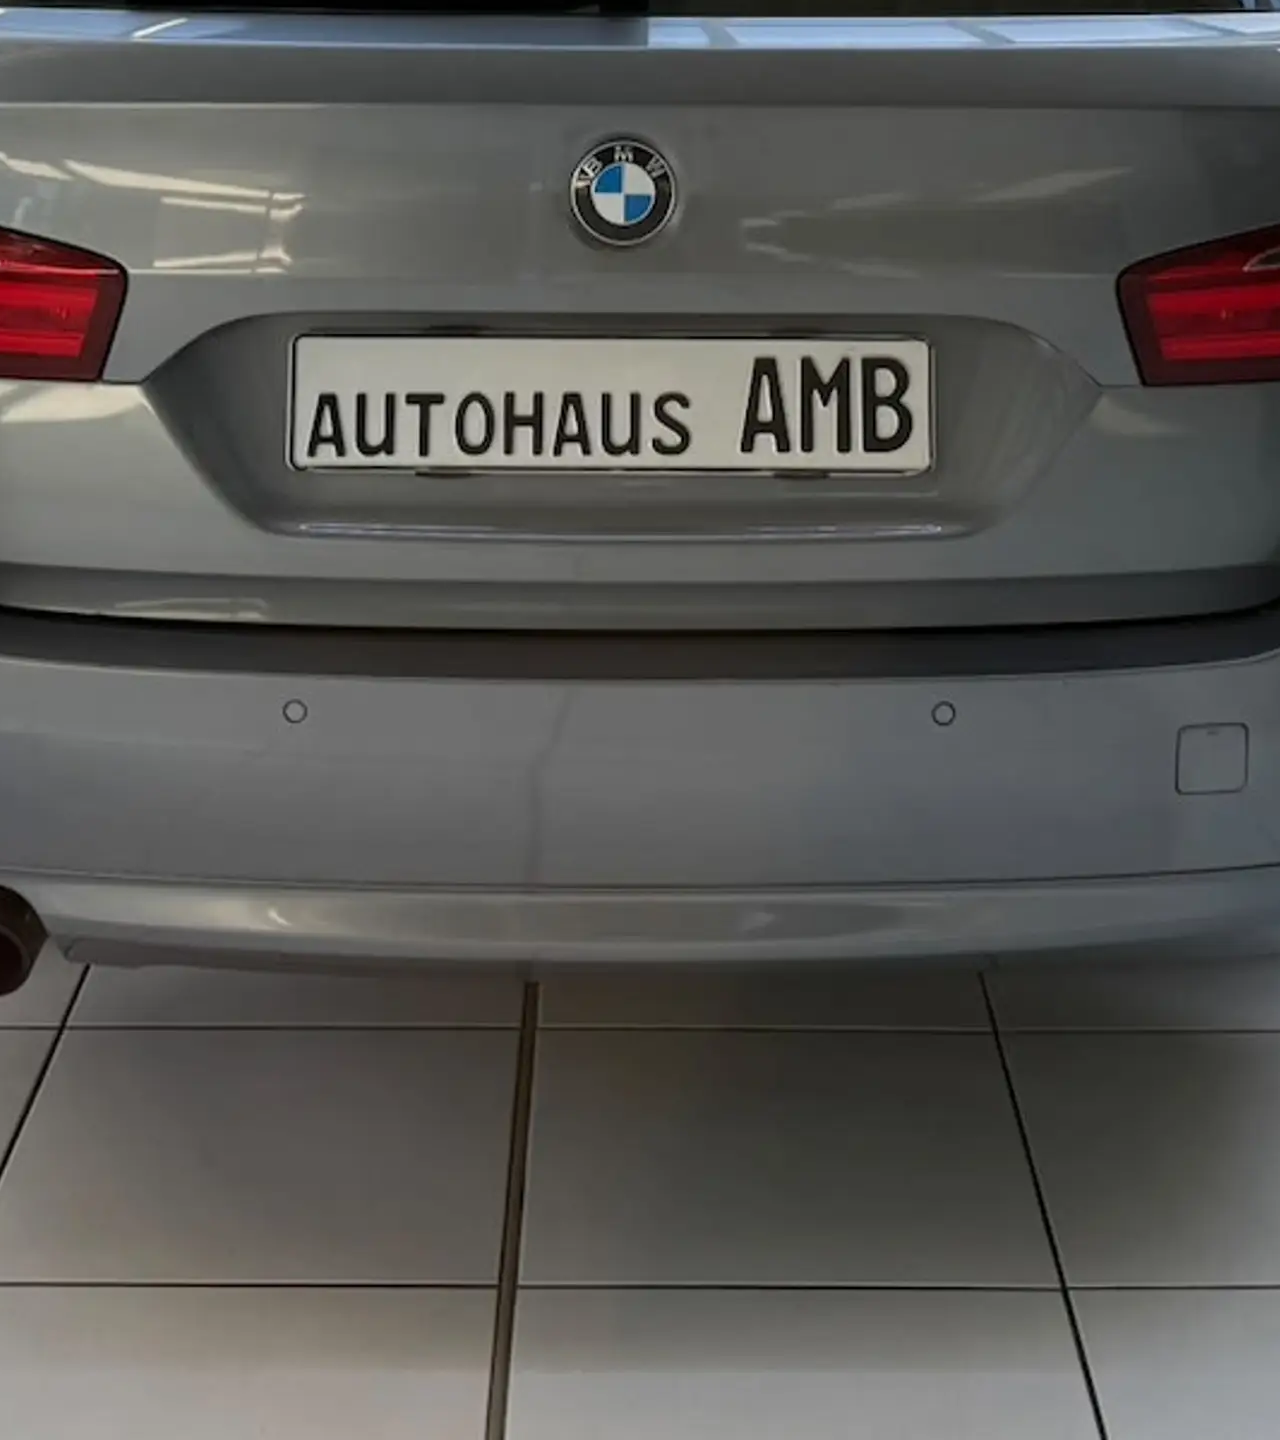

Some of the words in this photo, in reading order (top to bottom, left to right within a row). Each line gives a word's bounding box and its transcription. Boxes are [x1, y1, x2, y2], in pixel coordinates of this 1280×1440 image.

[580, 145, 667, 179] BMW
[306, 392, 692, 458] AUTOHAUS
[739, 356, 914, 454] AMB
